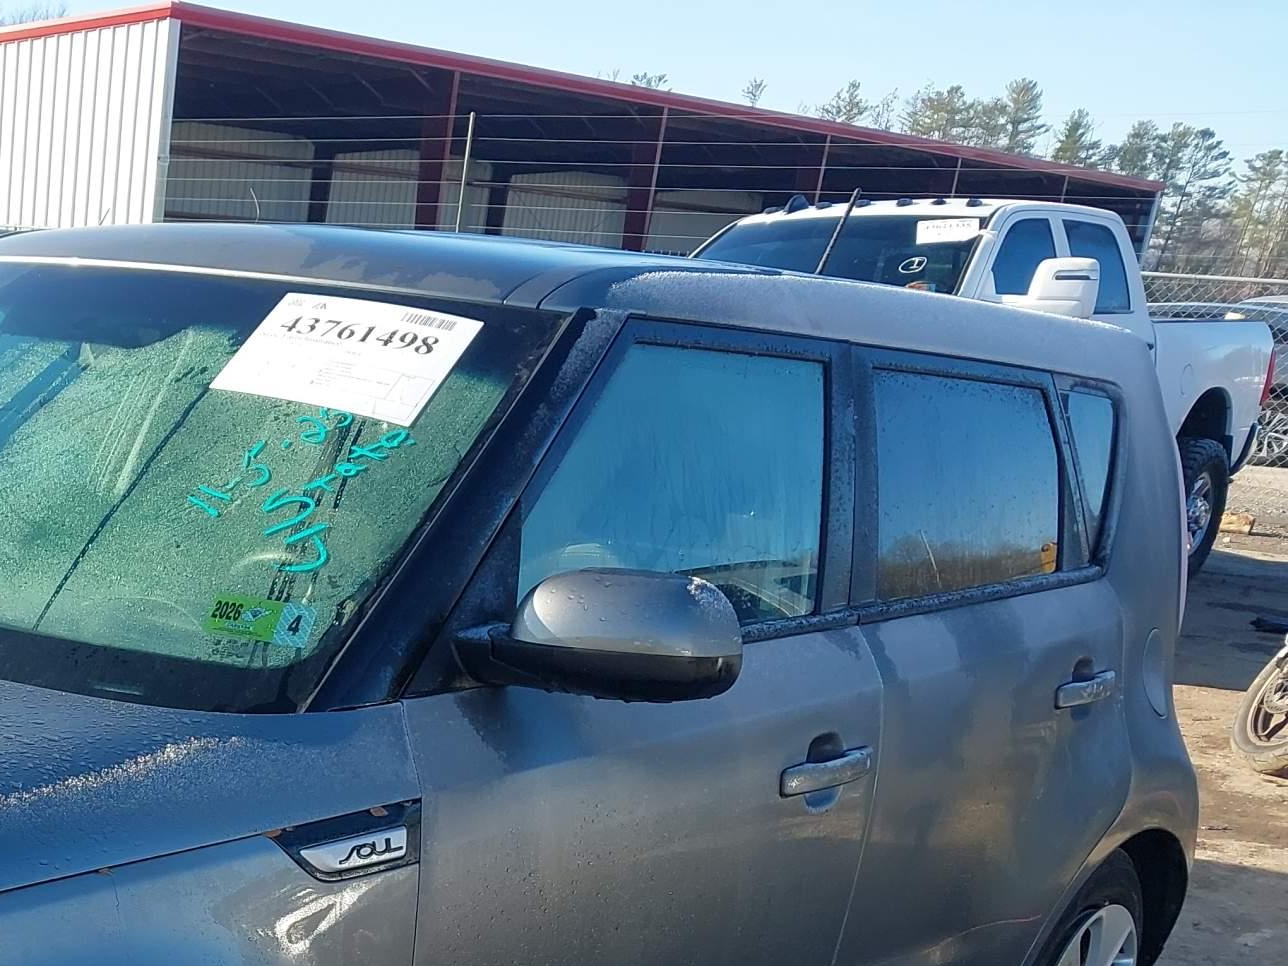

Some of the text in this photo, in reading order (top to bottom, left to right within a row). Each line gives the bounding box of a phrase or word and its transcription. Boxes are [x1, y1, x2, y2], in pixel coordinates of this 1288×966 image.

[280, 315, 440, 355] 43761498
[211, 600, 303, 636] 2026 4
[339, 837, 404, 865] SOUL
